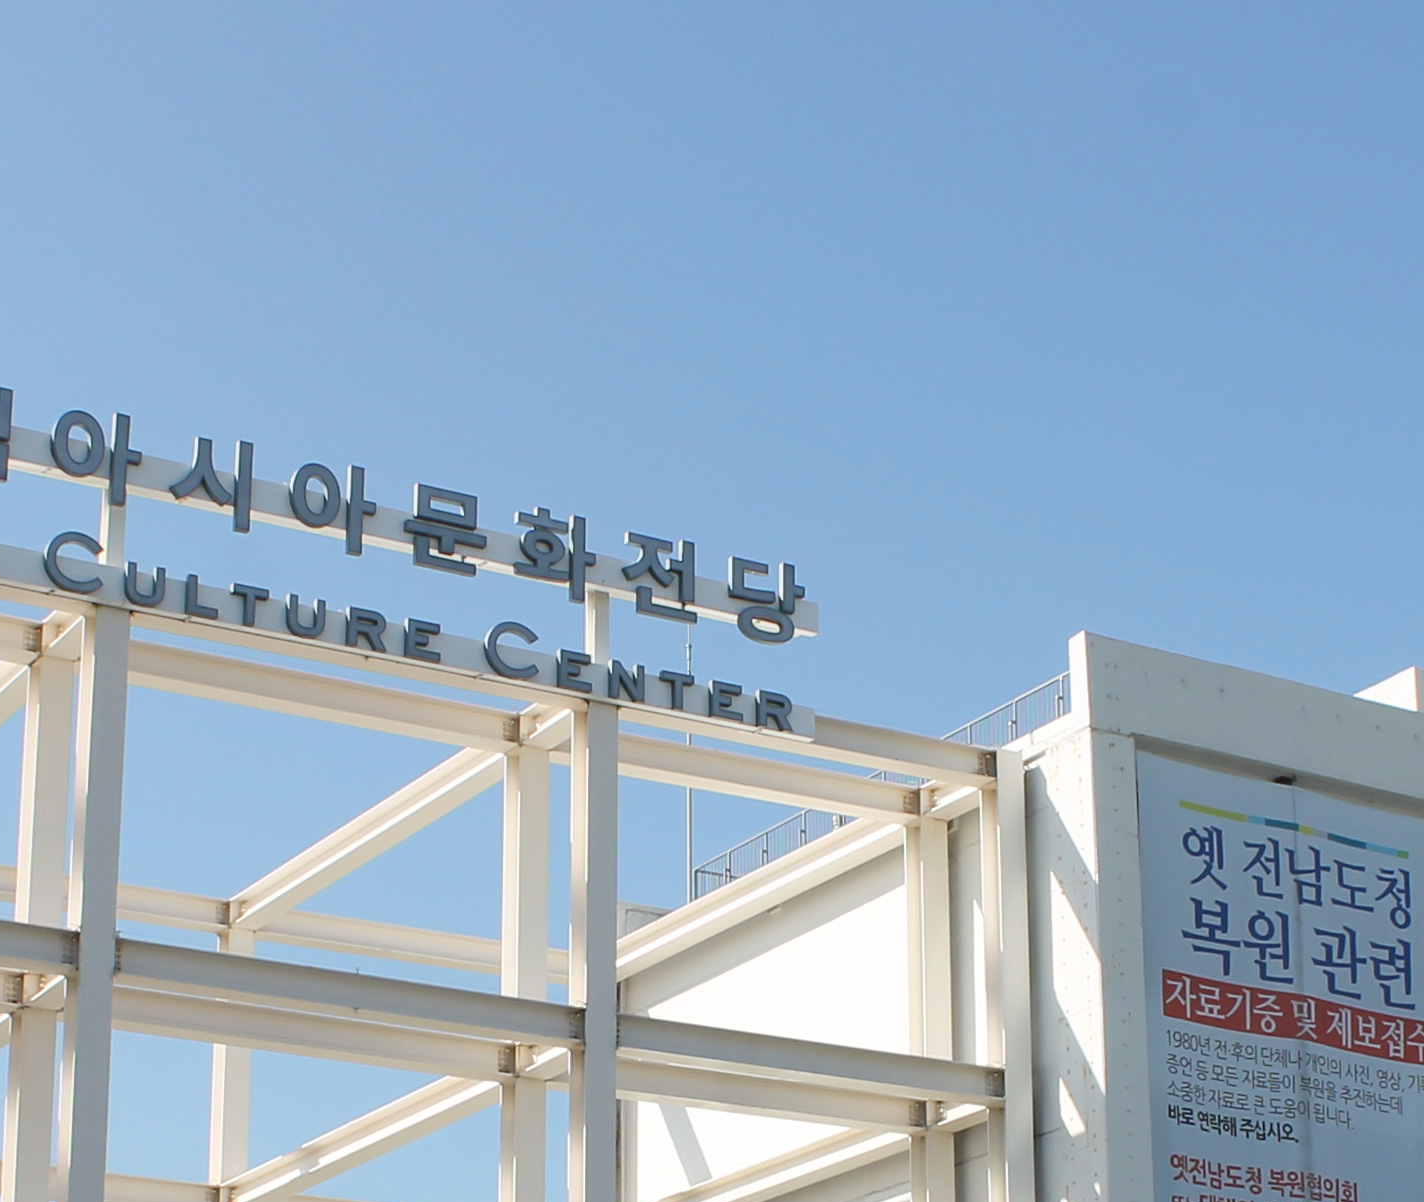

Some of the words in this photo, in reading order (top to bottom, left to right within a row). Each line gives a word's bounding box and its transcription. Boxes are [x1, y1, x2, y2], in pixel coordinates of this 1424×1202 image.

[1181, 825, 1228, 890] 옛
[1242, 837, 1412, 929] 전남도청
[1181, 897, 1294, 985] 복원
[1311, 925, 1416, 1011] 관련
[1165, 976, 1283, 1033] 자료기증
[1291, 998, 1319, 1040] 및
[1166, 1029, 1211, 1057] 1980년
[1261, 1047, 1302, 1070] 단체나
[1305, 1052, 1342, 1079] 개인의
[1345, 1063, 1374, 1087] 사진,
[1377, 1068, 1405, 1092] 영상,
[1166, 1054, 1193, 1078] 증언
[1195, 1060, 1209, 1081] 등
[1211, 1064, 1238, 1087] 모든
[1241, 1070, 1296, 1094] 자료들이
[1299, 1075, 1337, 1100] 복원을
[1340, 1085, 1403, 1115] 추진하는데
[1167, 1080, 1206, 1103] 소중한
[1208, 1090, 1251, 1112] 자료로
[1253, 1097, 1265, 1116] 큰
[1269, 1098, 1310, 1120] 도움이
[1313, 1104, 1355, 1130] 됩니다.
[1167, 1104, 1195, 1126] 바로
[1197, 1111, 1237, 1137] 연락해
[1240, 1118, 1299, 1143] 주십시오.
[1170, 1154, 1263, 1195] 옛전남도청
